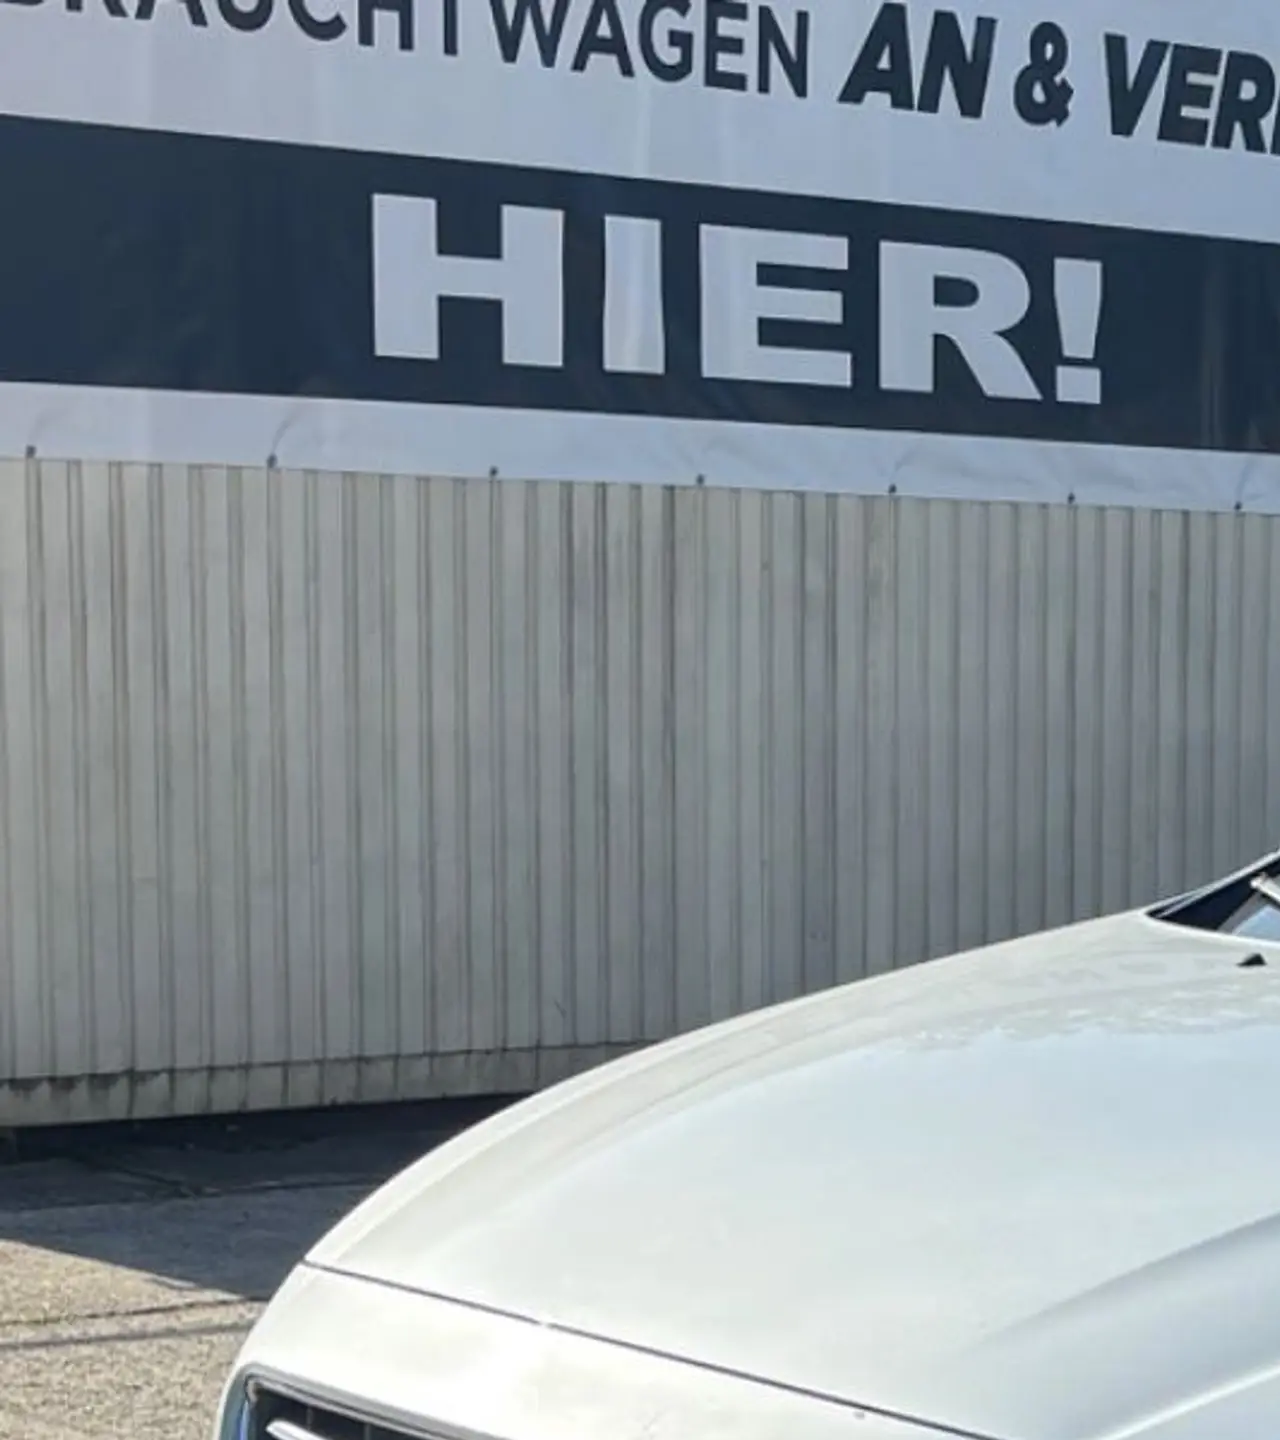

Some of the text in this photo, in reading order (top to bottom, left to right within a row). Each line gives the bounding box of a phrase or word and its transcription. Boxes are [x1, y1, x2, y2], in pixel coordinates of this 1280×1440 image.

[839, 8, 997, 120] AN
[1012, 21, 1074, 128] &
[371, 192, 1104, 405] HIER!
